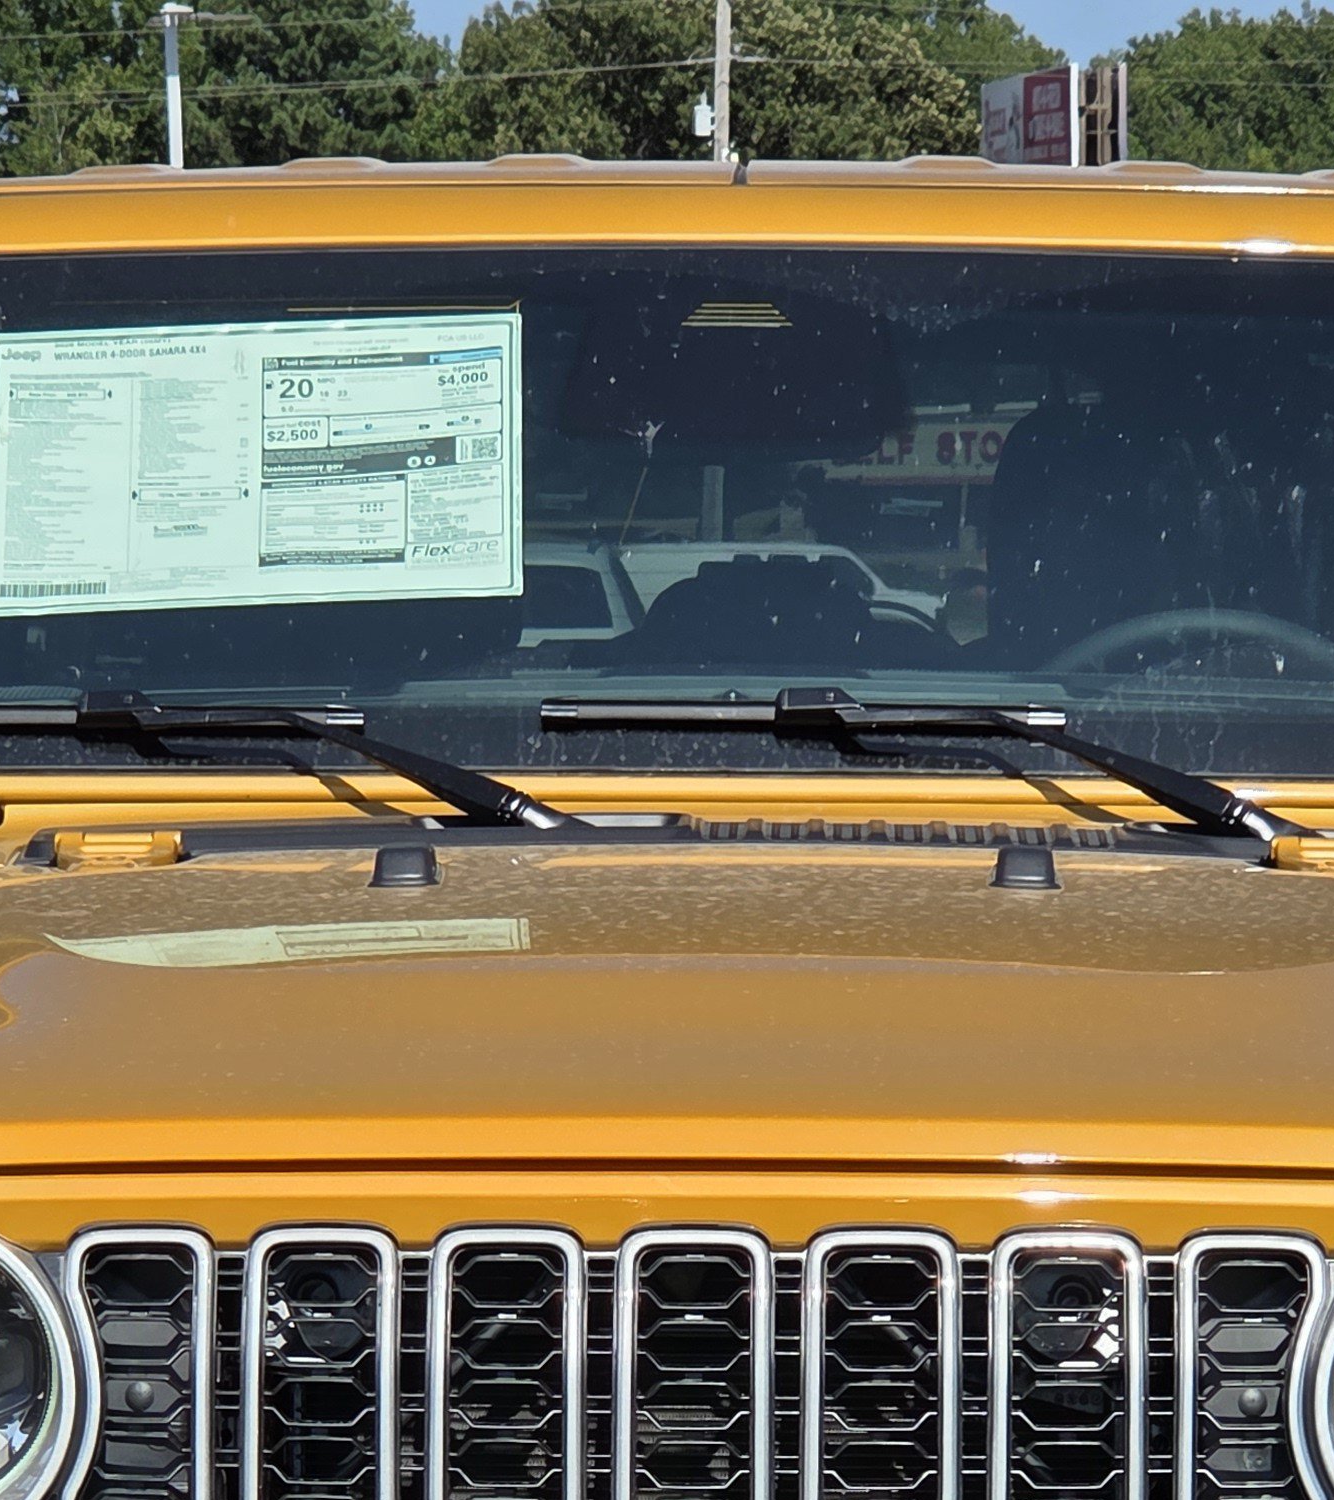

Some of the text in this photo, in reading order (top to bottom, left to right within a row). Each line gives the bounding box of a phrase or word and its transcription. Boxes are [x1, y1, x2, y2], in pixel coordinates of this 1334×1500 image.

[1, 348, 42, 362] Jeep
[54, 345, 207, 361] WRANGLER 4-DOOR SAHARA 4X4
[452, 362, 486, 374] spend
[437, 371, 489, 387] $4,000
[279, 378, 314, 399] 20
[297, 419, 322, 427] cost
[267, 429, 319, 443] $2,500
[411, 540, 499, 558] FlexCare
